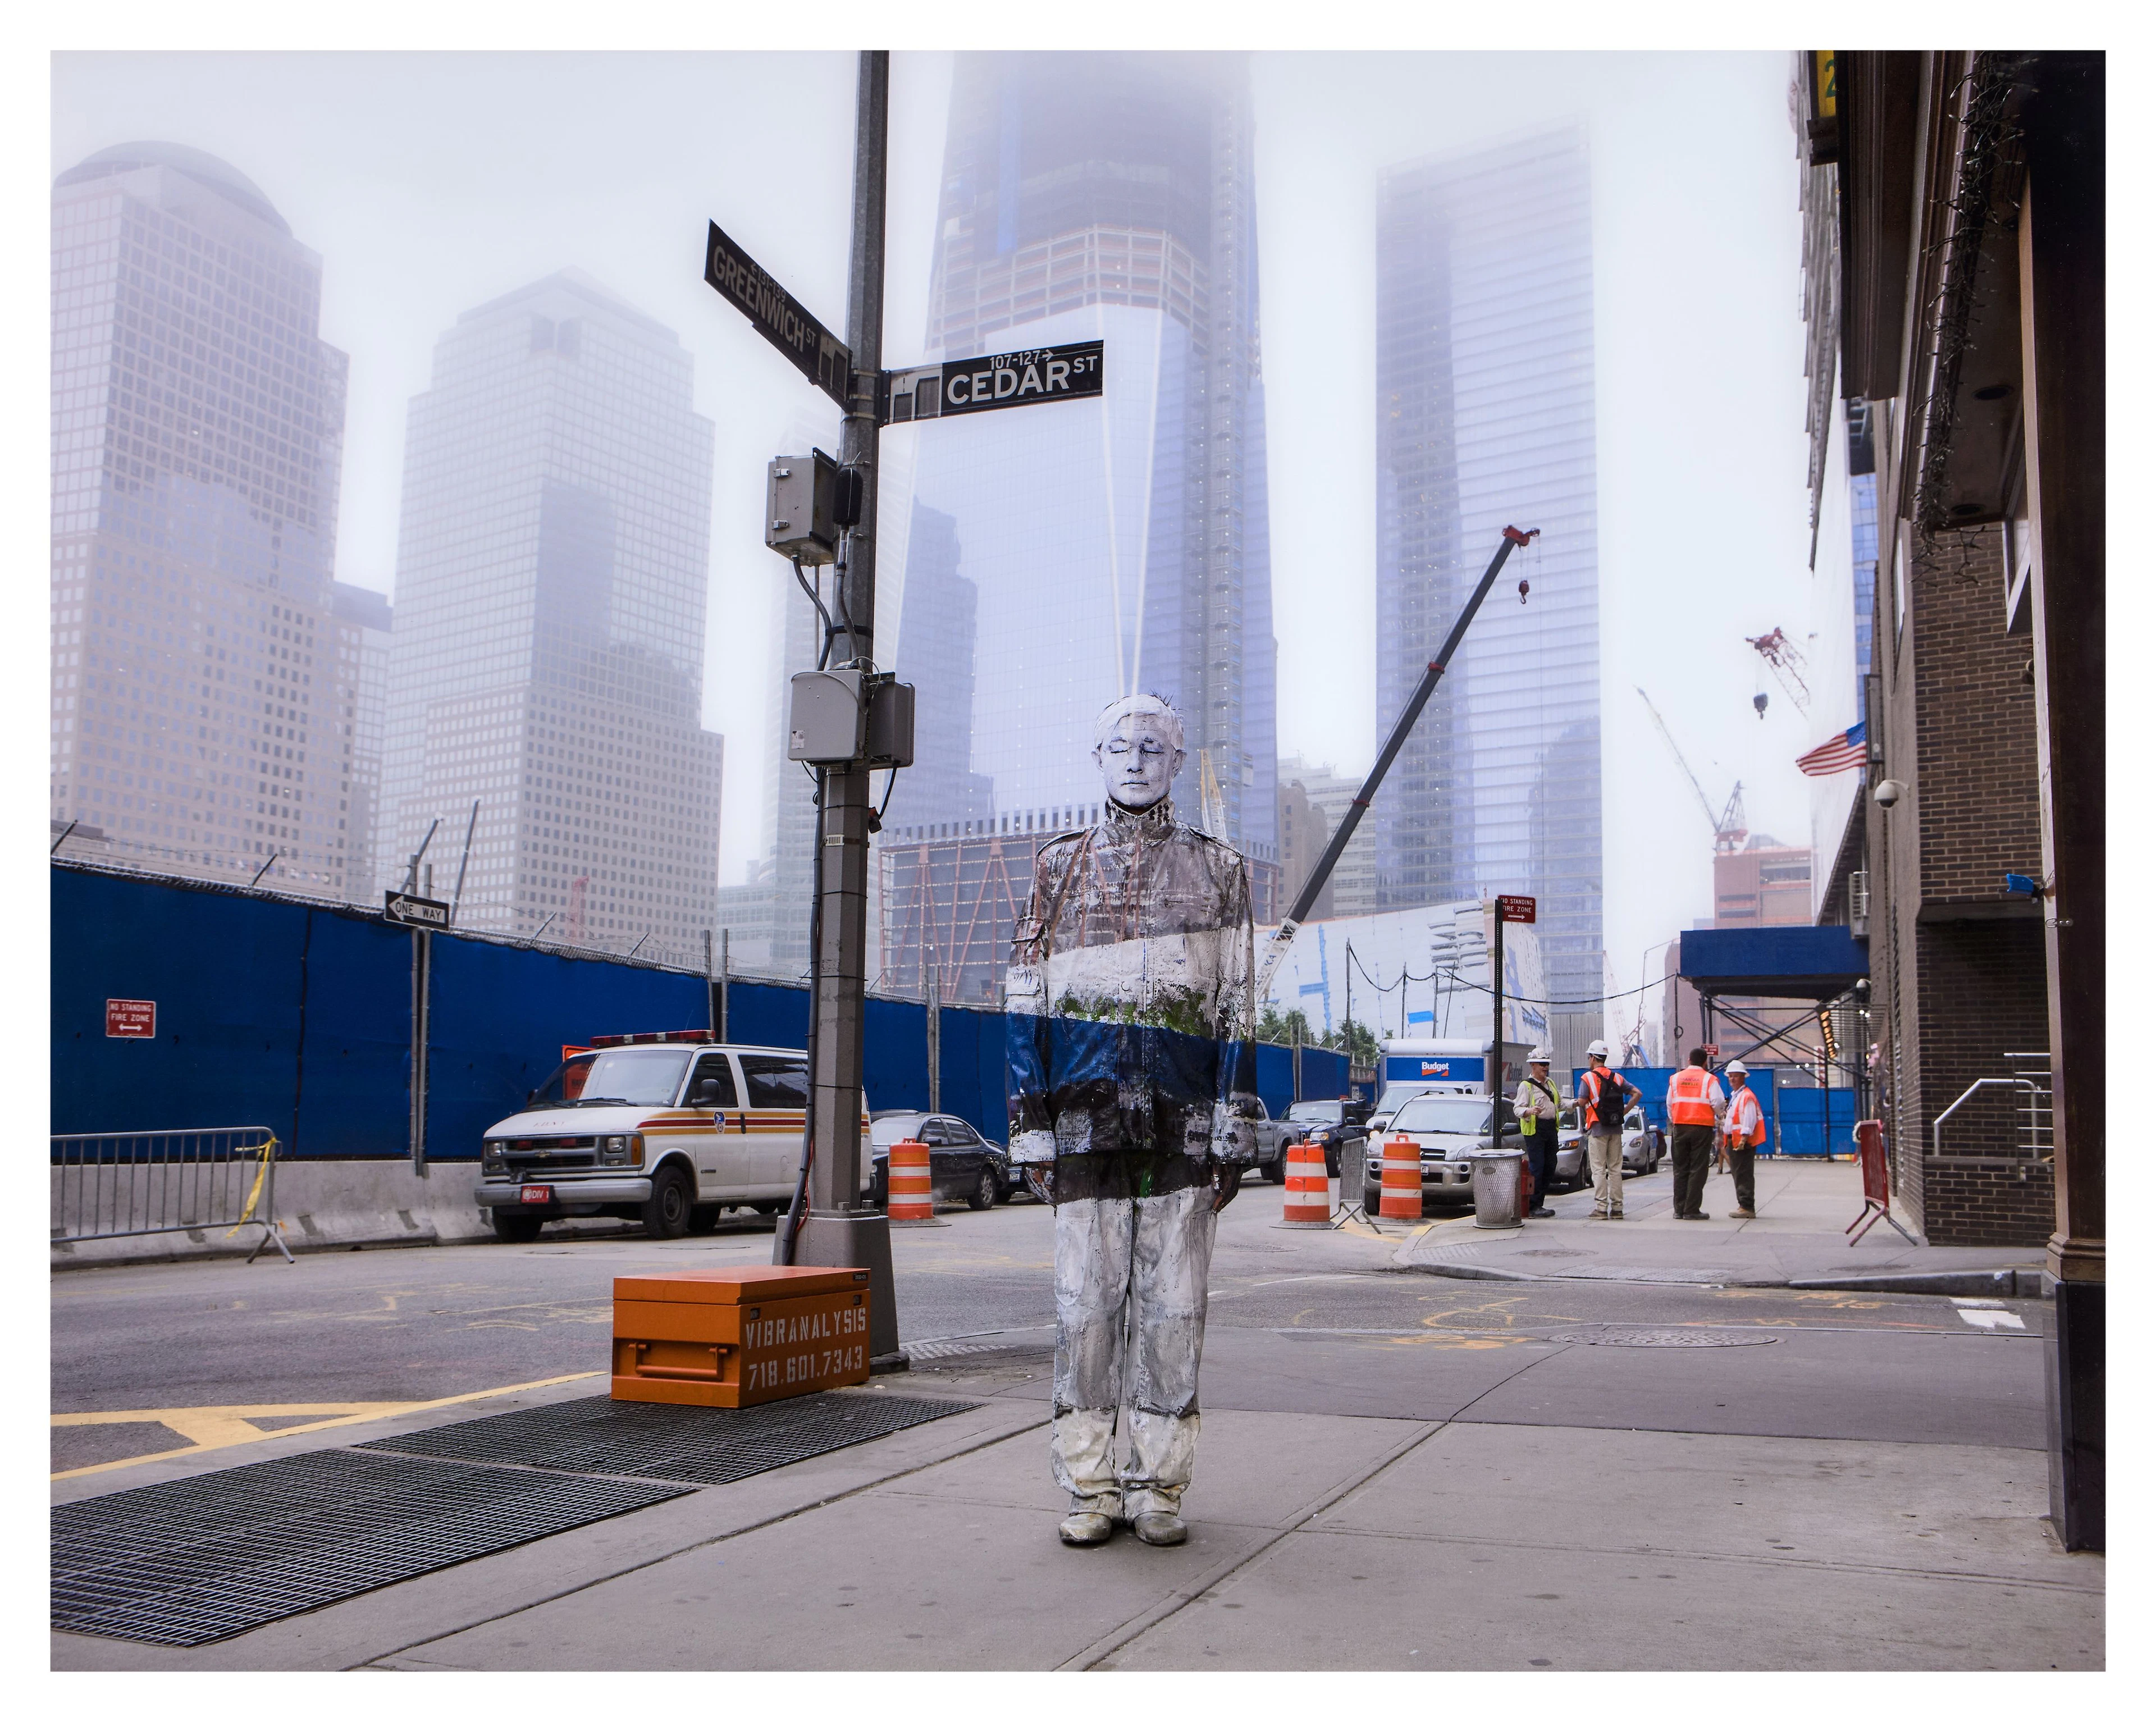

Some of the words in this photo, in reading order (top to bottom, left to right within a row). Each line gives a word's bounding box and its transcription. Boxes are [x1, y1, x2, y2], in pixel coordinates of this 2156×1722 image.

[757, 267, 786, 303] 131-139
[714, 245, 805, 353] GREENWICH
[806, 327, 816, 348] ST
[989, 350, 1040, 371] 107-127
[947, 360, 1070, 405] CEDAR
[1073, 355, 1098, 374] ST
[395, 902, 414, 916] ONE
[422, 907, 441, 921] WAY
[111, 1013, 127, 1021] FIRE
[131, 1013, 150, 1022] ZONE
[121, 1003, 152, 1012] STANDING
[1421, 1061, 1450, 1072] Budget
[532, 1190, 544, 1199] DIV
[546, 1191, 549, 1199] 1
[746, 1307, 866, 1349] VIBRANALYSIS
[748, 1345, 863, 1391] 718.601.7343
